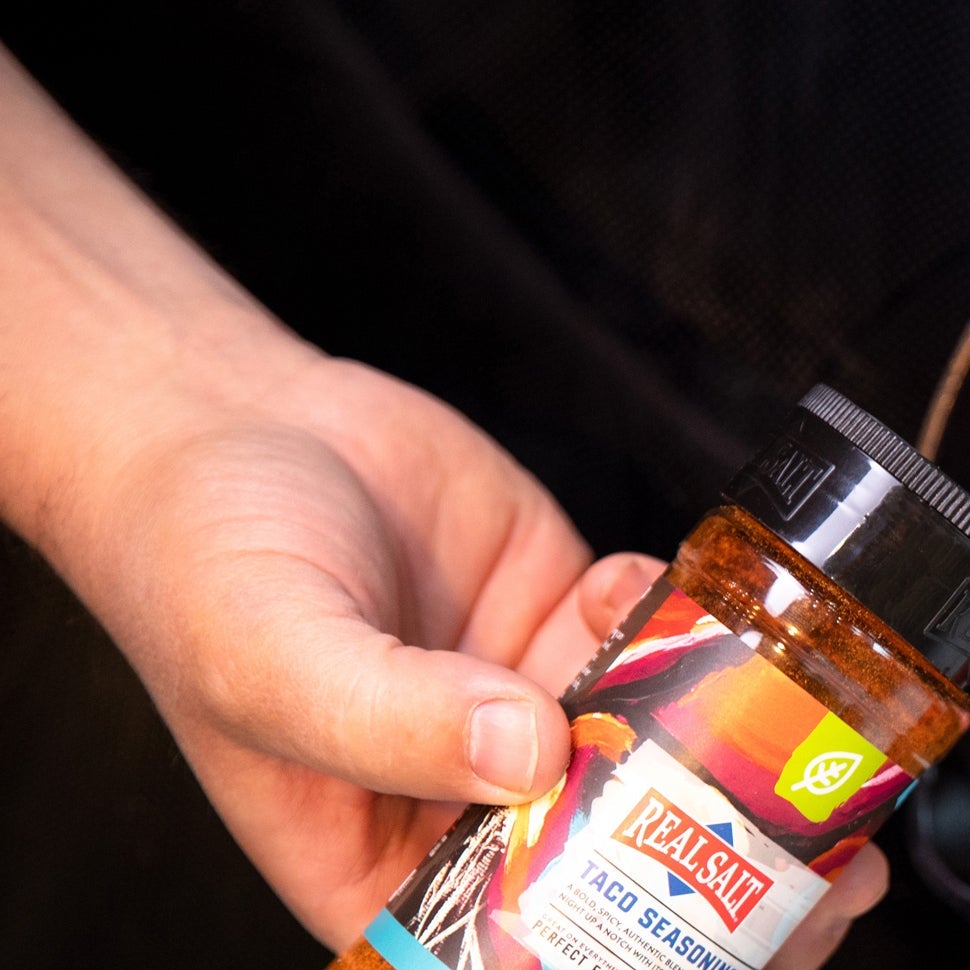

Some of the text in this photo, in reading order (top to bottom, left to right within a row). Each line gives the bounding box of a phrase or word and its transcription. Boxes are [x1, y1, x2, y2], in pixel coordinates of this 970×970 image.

[580, 860, 638, 913] TACO
[622, 797, 764, 920] REAL SALT
[532, 920, 588, 966] PERFECT
[558, 892, 585, 914] NIGHT
[584, 913, 597, 924] UP
[596, 923, 603, 931] A
[603, 928, 633, 952] NOTCH
[633, 949, 653, 967] WITH
[566, 933, 579, 943] ON
[573, 888, 597, 911] BOLD,
[623, 928, 667, 962] AUTHENTIC
